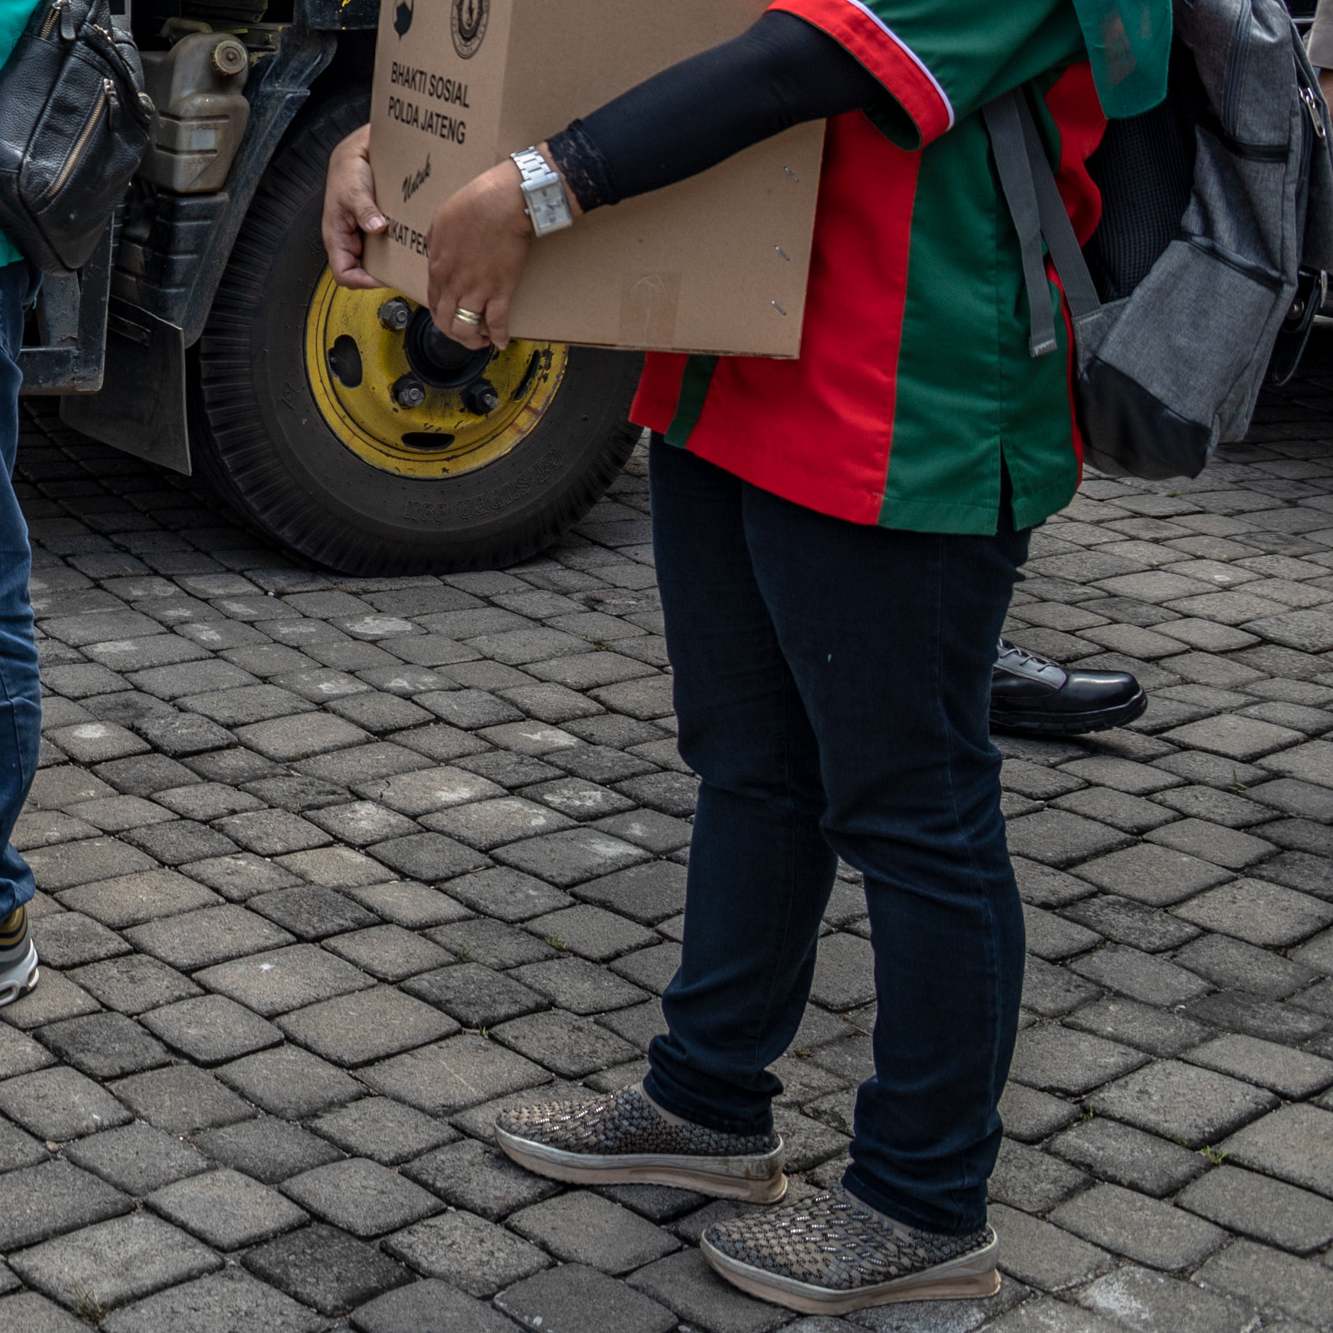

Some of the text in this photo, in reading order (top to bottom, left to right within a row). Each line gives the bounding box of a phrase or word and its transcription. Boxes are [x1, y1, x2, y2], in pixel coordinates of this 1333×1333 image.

[391, 61, 470, 109] BHAKTI SOSIAL
[388, 95, 467, 145] POLDA JATENG
[401, 152, 431, 204] Untuk
